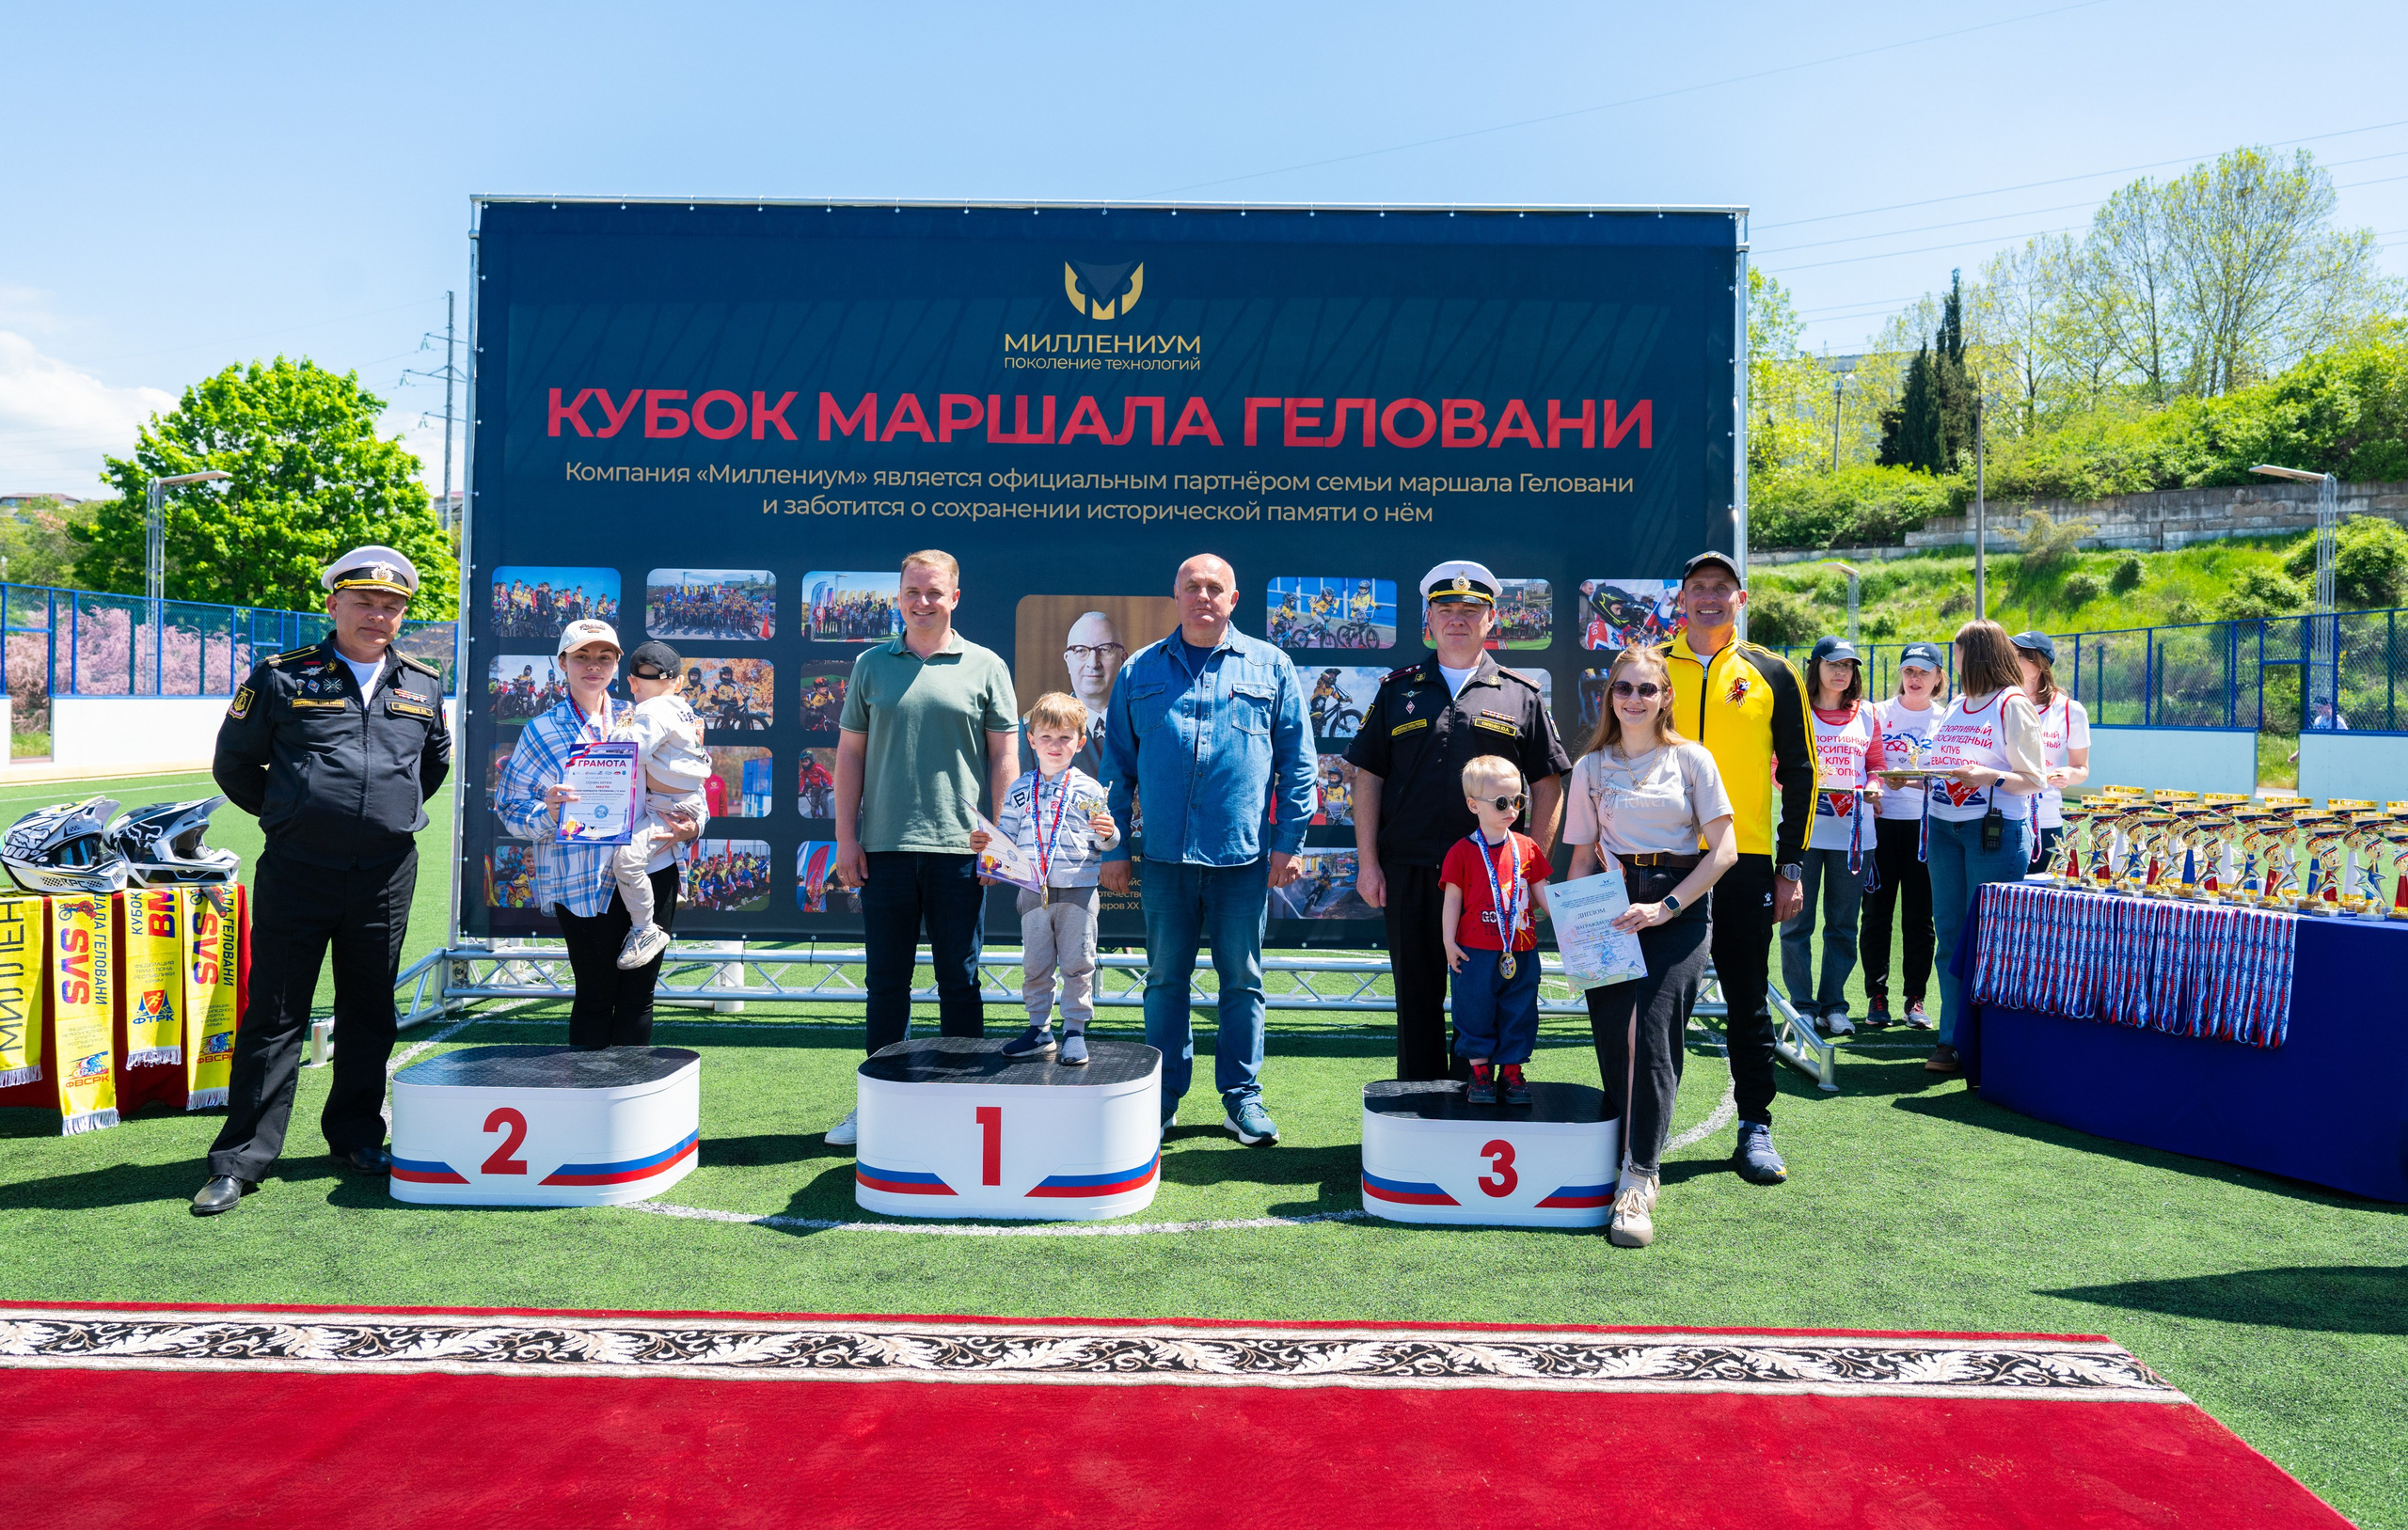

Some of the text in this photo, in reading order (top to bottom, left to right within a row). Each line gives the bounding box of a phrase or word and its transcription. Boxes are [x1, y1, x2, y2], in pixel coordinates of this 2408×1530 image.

[1005, 333, 1200, 355] МИЛЛЕНИУМ
[1005, 356, 1200, 371] поколение технологий
[547, 387, 1653, 449] КУБОК МАРШАЛА ГЕЛОВАНИ
[566, 462, 1634, 497] Компания «Миллениум» является официальным партнёром семьи маршала Геловани
[763, 494, 1434, 525] и заботится о сохранении исторической памяти о нём
[1815, 734, 1869, 748] ПОРТИВНЫЙ
[1939, 725, 1992, 736] СПОРТИВНЫЙ
[578, 759, 626, 767] ГРАМОТА
[1816, 745, 1866, 757] ОСИПЕДНЫ
[1825, 756, 1850, 765] КЛУБ
[1941, 745, 1961, 755] КЛУБ
[130, 892, 142, 935] КУБОК
[1577, 907, 1606, 920] ДИПЛОМ
[192, 911, 218, 986] SVS
[222, 918, 235, 987] ГЕЛОВАНИ
[0, 900, 24, 1052] МИЛЛЕН
[60, 927, 90, 1005] SVS
[94, 934, 108, 1005] ГЕЛОВАНИ
[133, 1014, 175, 1025] ФТРК
[66, 1075, 110, 1088] ФВСРК
[481, 1107, 528, 1175] 2
[975, 1106, 1002, 1187] 1
[1478, 1139, 1519, 1198] 3
